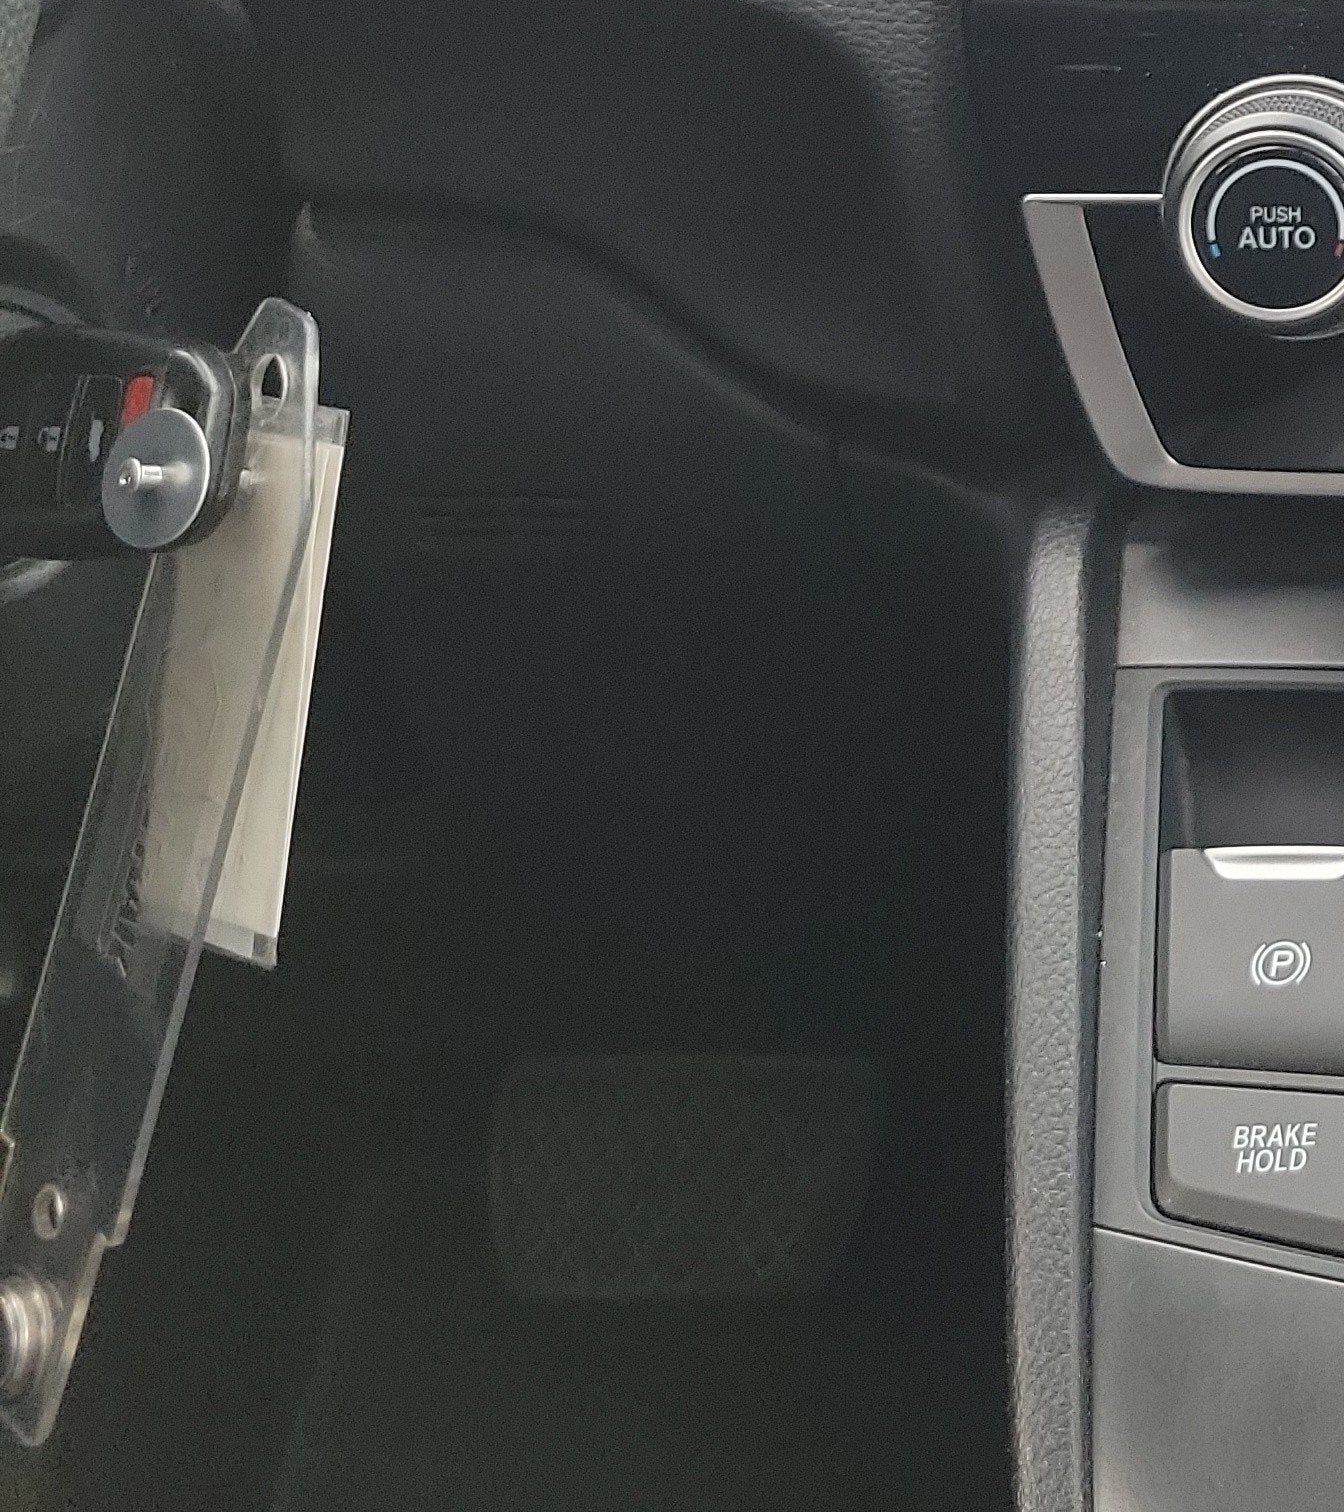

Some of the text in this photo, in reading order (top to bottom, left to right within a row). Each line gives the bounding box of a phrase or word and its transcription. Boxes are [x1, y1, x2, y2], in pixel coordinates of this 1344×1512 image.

[1250, 205, 1302, 224] PUSH
[1238, 226, 1316, 251] AUTO
[1233, 1123, 1317, 1147] BRAKE
[1236, 1148, 1307, 1173] HOLD
